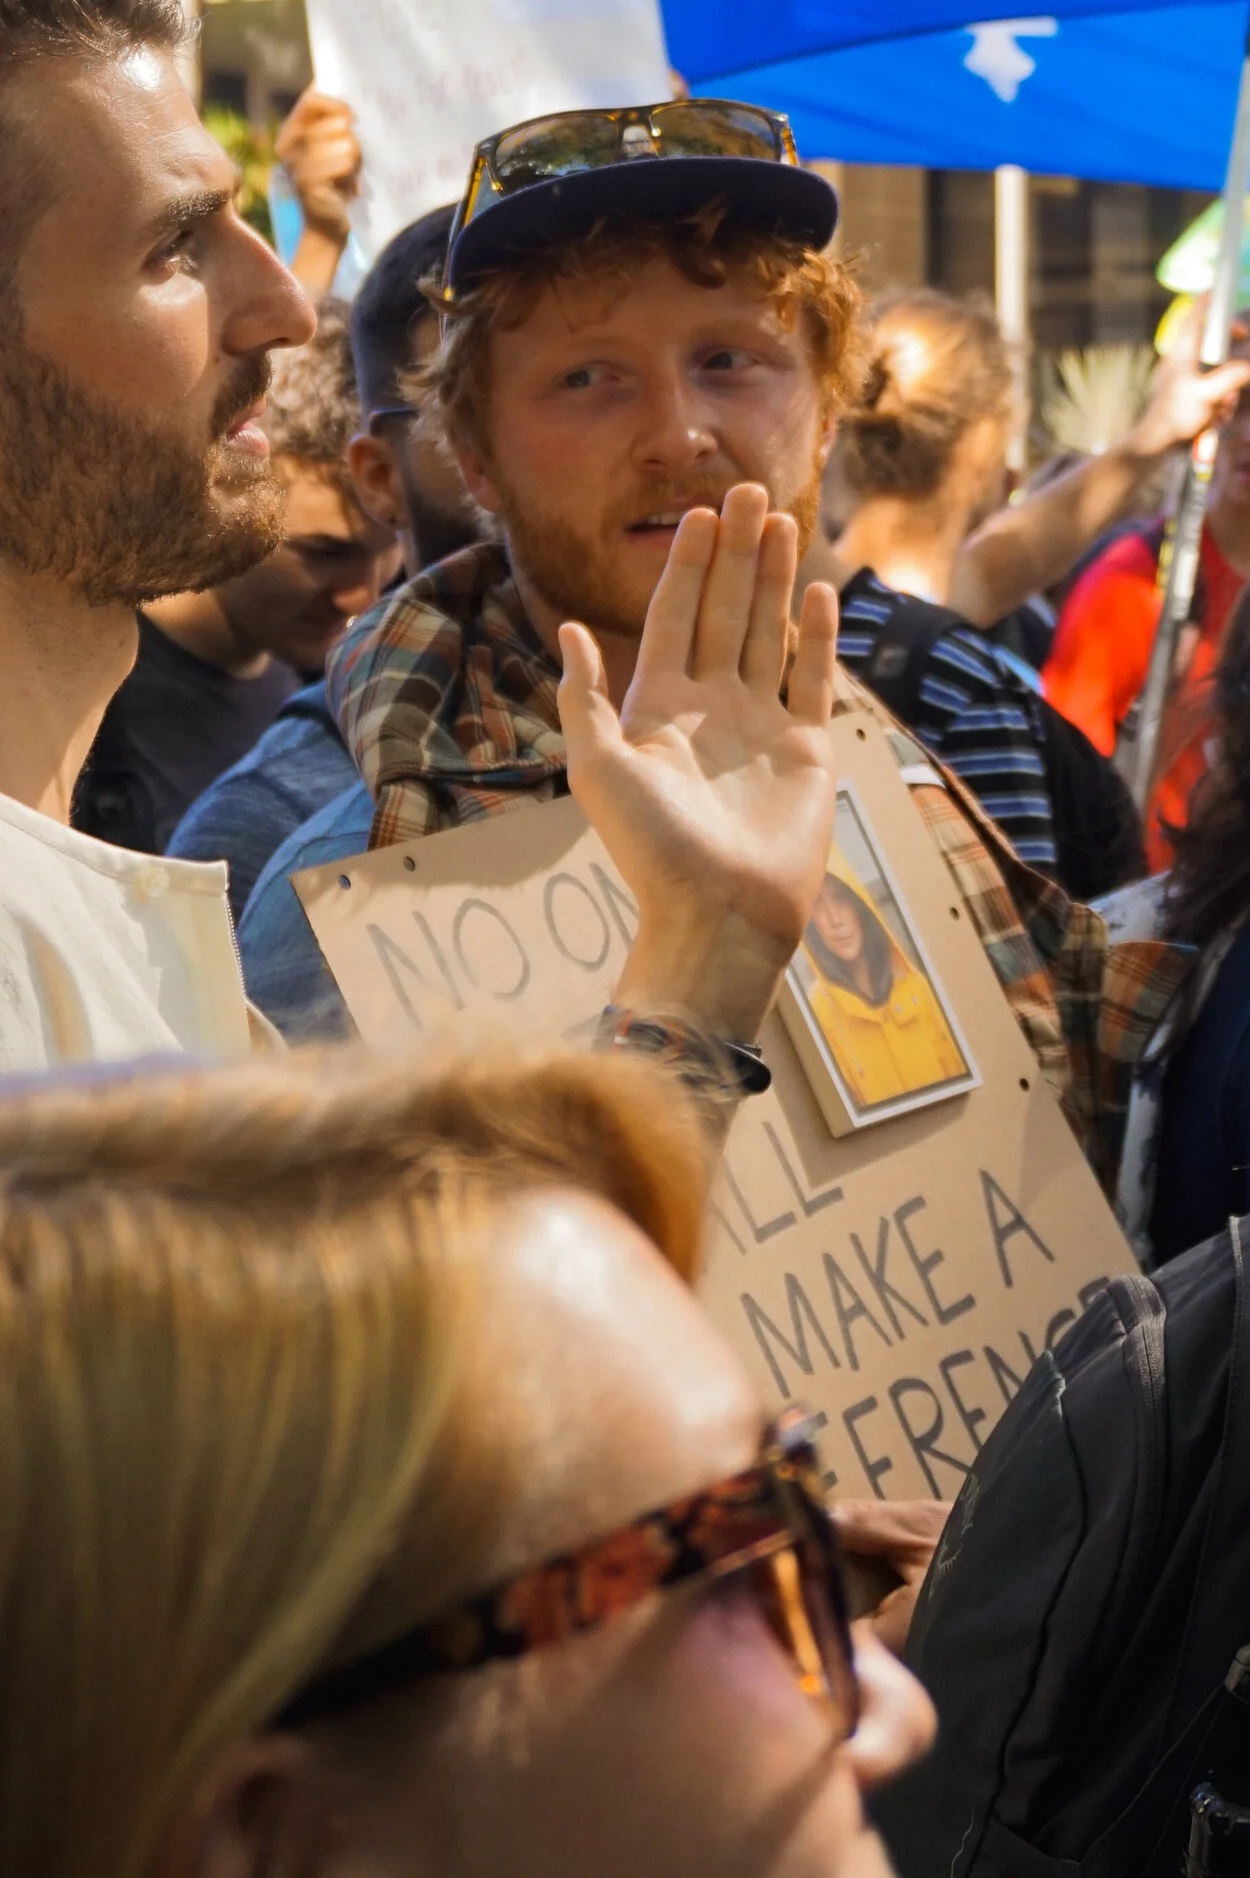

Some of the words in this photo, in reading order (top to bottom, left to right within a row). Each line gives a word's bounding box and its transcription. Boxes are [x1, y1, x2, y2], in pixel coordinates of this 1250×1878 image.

[366, 898, 531, 1031] NO
[740, 1195, 977, 1399] MAKE
[979, 1168, 1055, 1288] A
